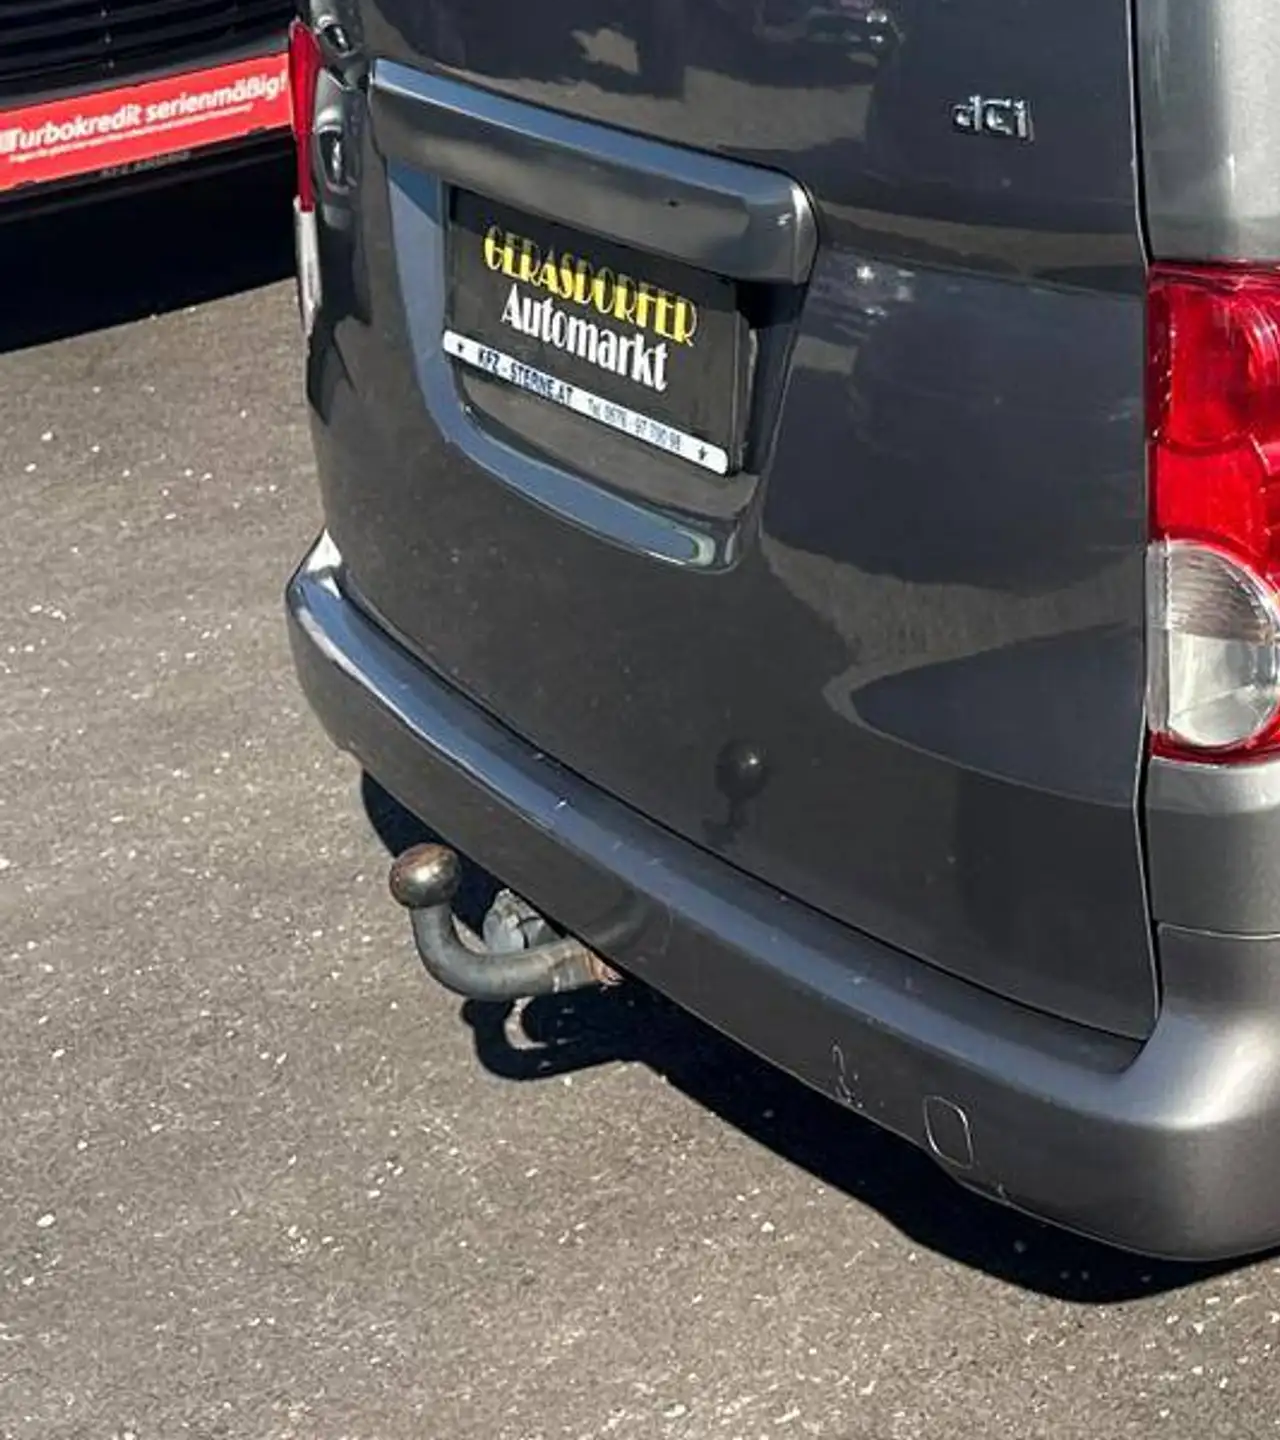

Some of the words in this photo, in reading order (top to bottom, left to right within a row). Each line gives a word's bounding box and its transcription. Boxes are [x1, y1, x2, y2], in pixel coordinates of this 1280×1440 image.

[10, 103, 143, 150] Turbokredit
[145, 70, 288, 123] serienmäßig!
[484, 225, 698, 348] GERASDORFER
[501, 282, 668, 392] Automarkt
